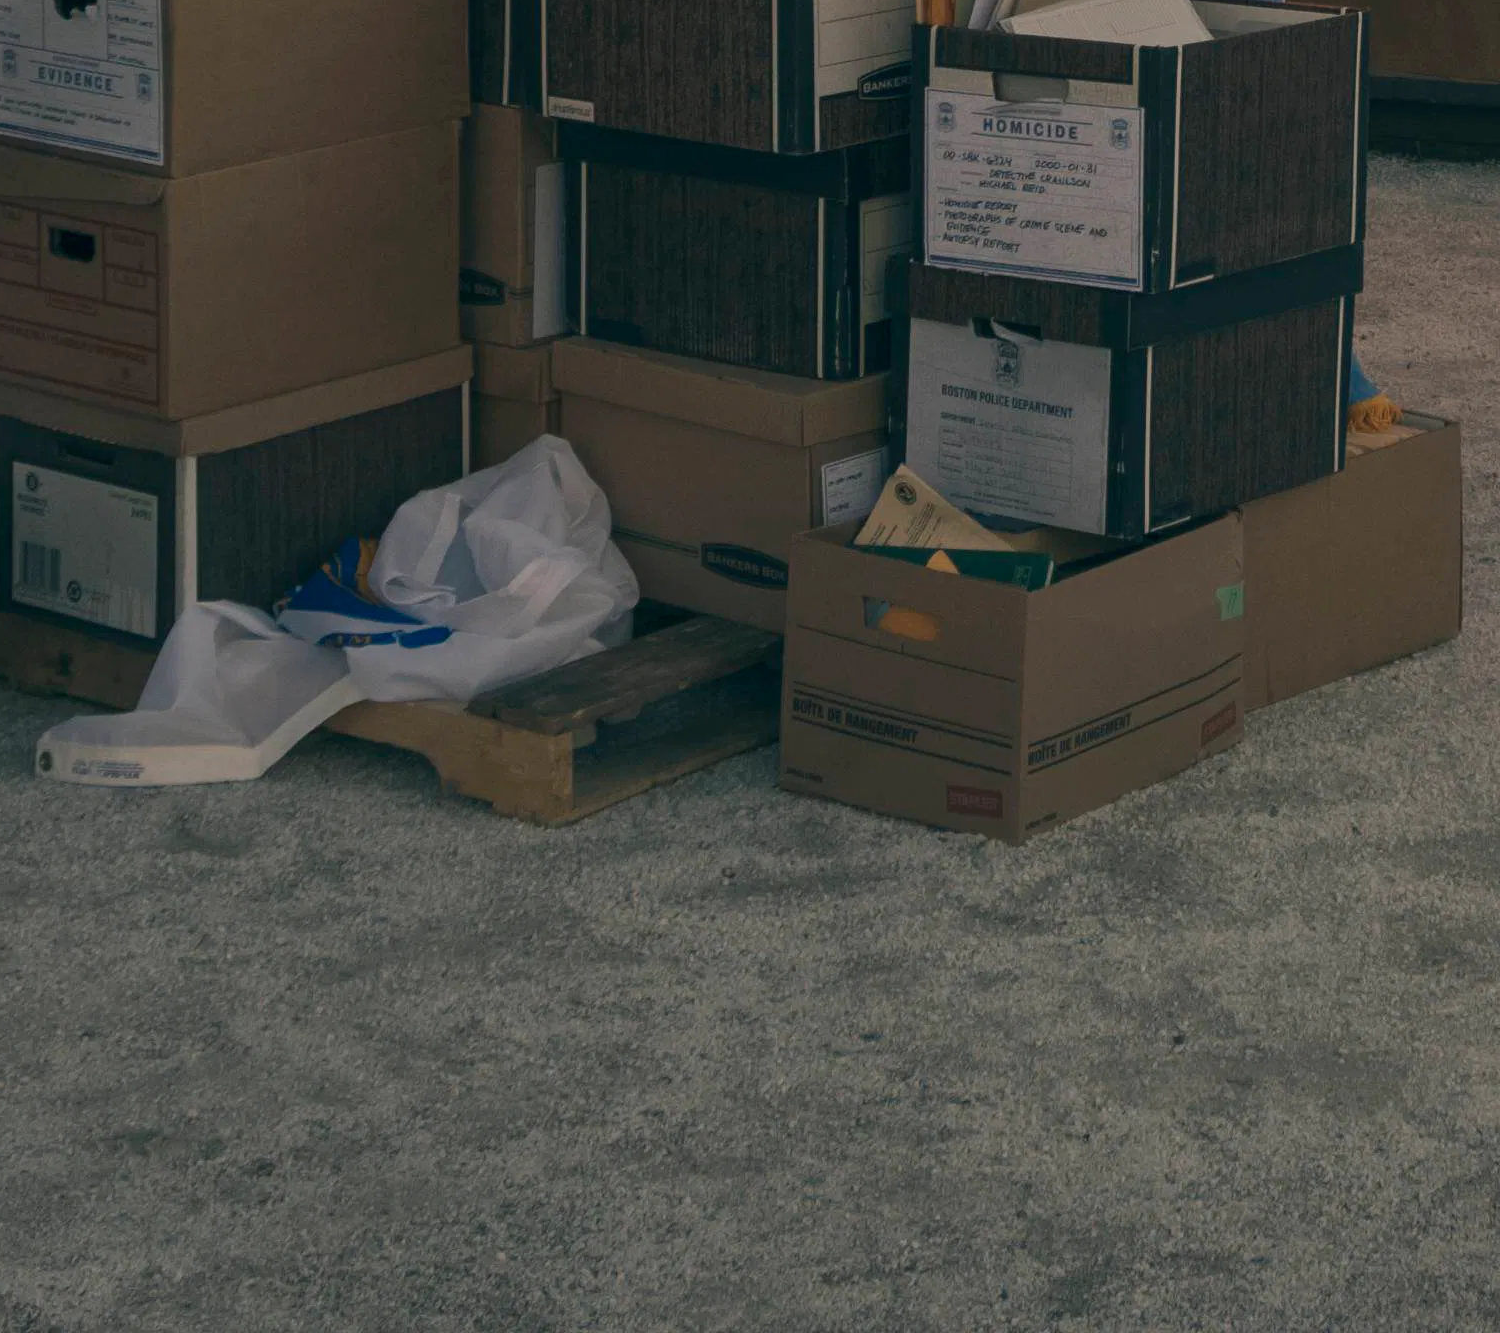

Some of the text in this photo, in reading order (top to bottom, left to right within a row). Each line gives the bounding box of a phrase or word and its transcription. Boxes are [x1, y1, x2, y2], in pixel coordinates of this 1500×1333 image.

[37, 66, 113, 92] EVIDENCE
[983, 118, 1078, 140] HOMICIDE
[979, 180, 1017, 191] MICHAEL
[1005, 216, 1017, 226] OF
[1019, 219, 1052, 231] CRIME
[1054, 221, 1085, 234] SCENE
[1089, 227, 1108, 238] AND
[982, 238, 1021, 254] REPORT
[941, 384, 1074, 419] BOSTON POLICE DEPARTMENT
[828, 707, 843, 725] DE
[845, 713, 919, 745] RANGEMENT
[1059, 738, 1073, 755] DE
[1074, 712, 1132, 750] RANGEMENT
